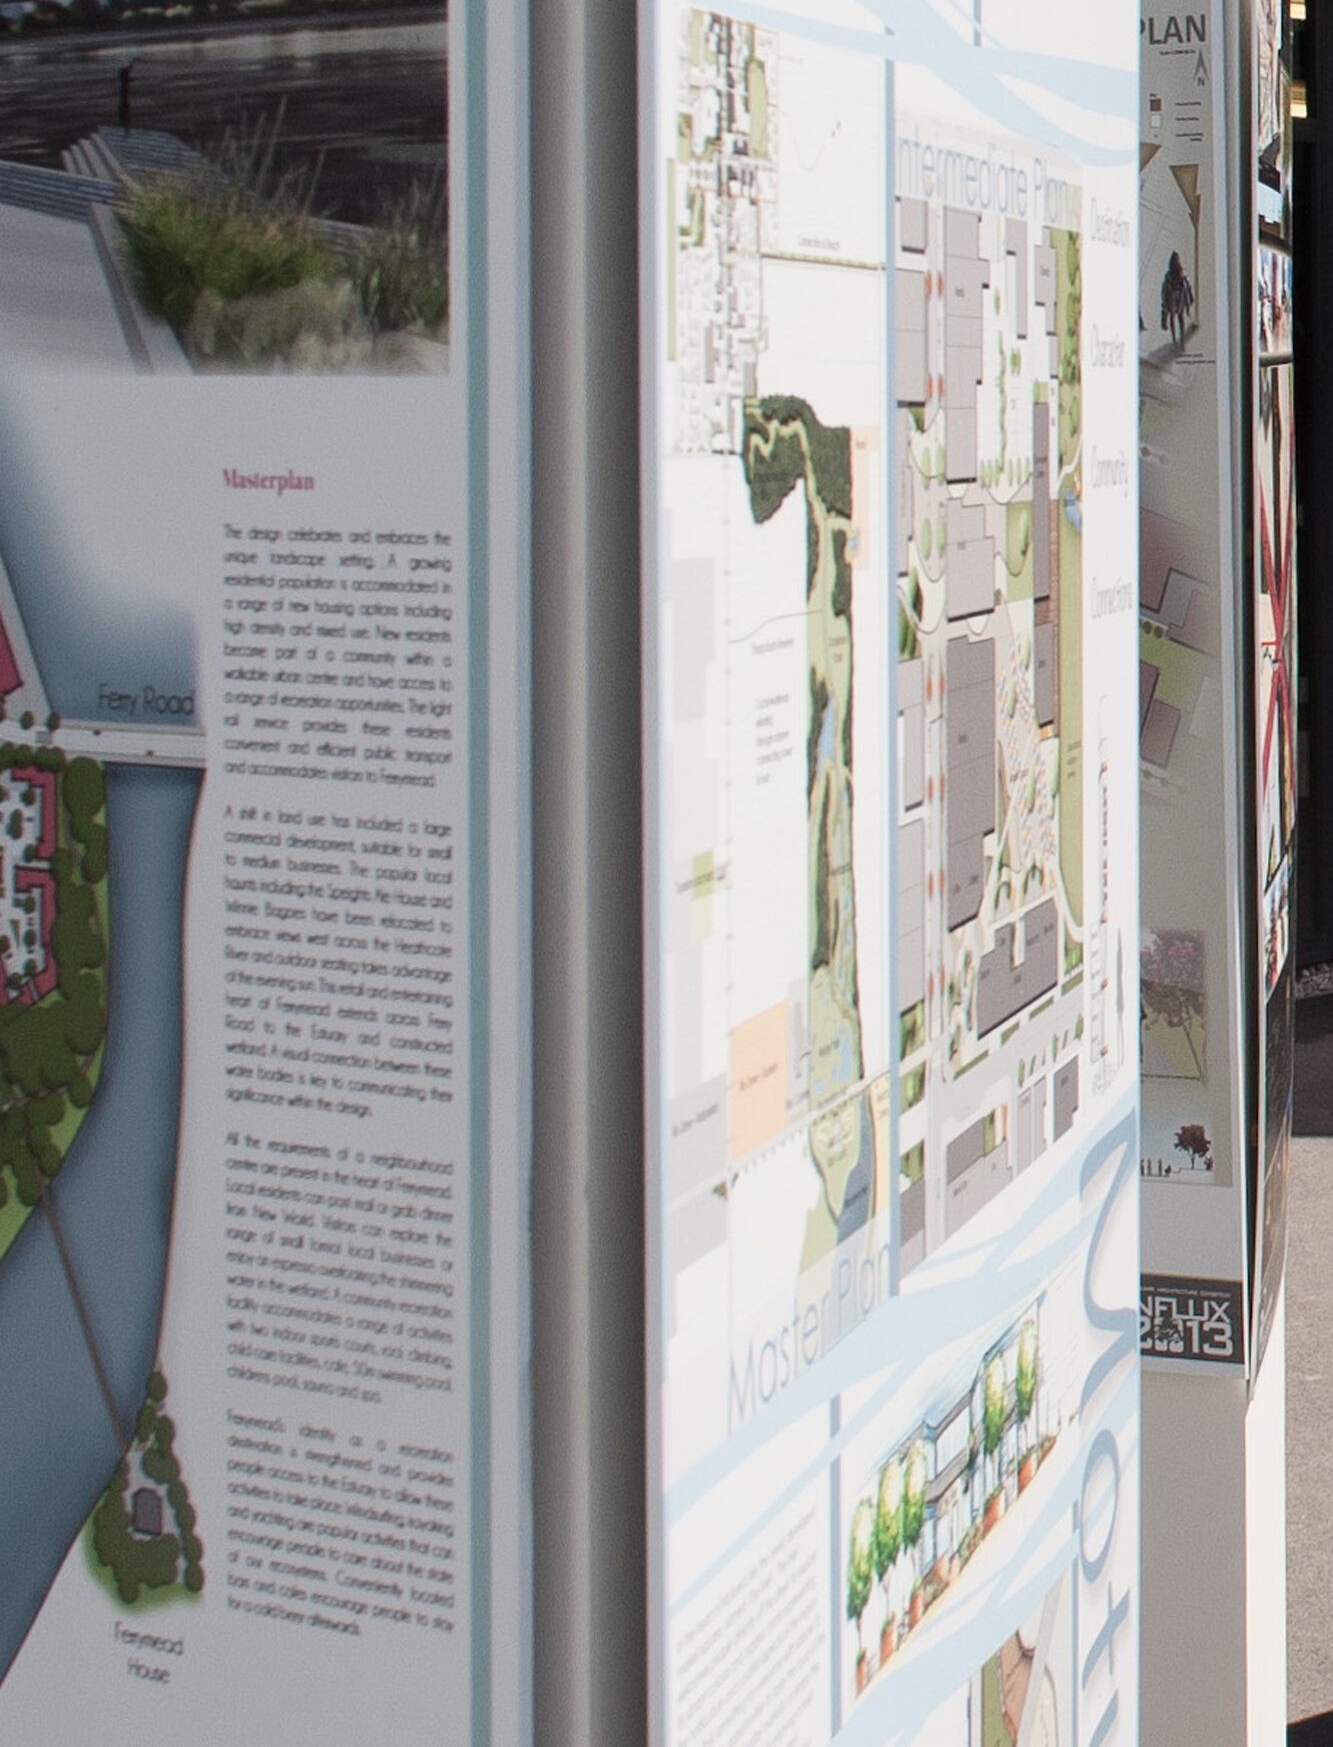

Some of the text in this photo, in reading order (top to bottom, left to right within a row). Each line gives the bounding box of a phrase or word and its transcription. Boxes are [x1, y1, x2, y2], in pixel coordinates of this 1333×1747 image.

[896, 122, 1028, 219] ntermediate
[223, 467, 315, 496] Masterplan
[145, 684, 195, 717] Road
[1140, 1296, 1231, 1322] NFLUX
[727, 1241, 891, 1436] Master Plan
[112, 1620, 185, 1657] Ferrymead
[127, 1657, 171, 1685] House
